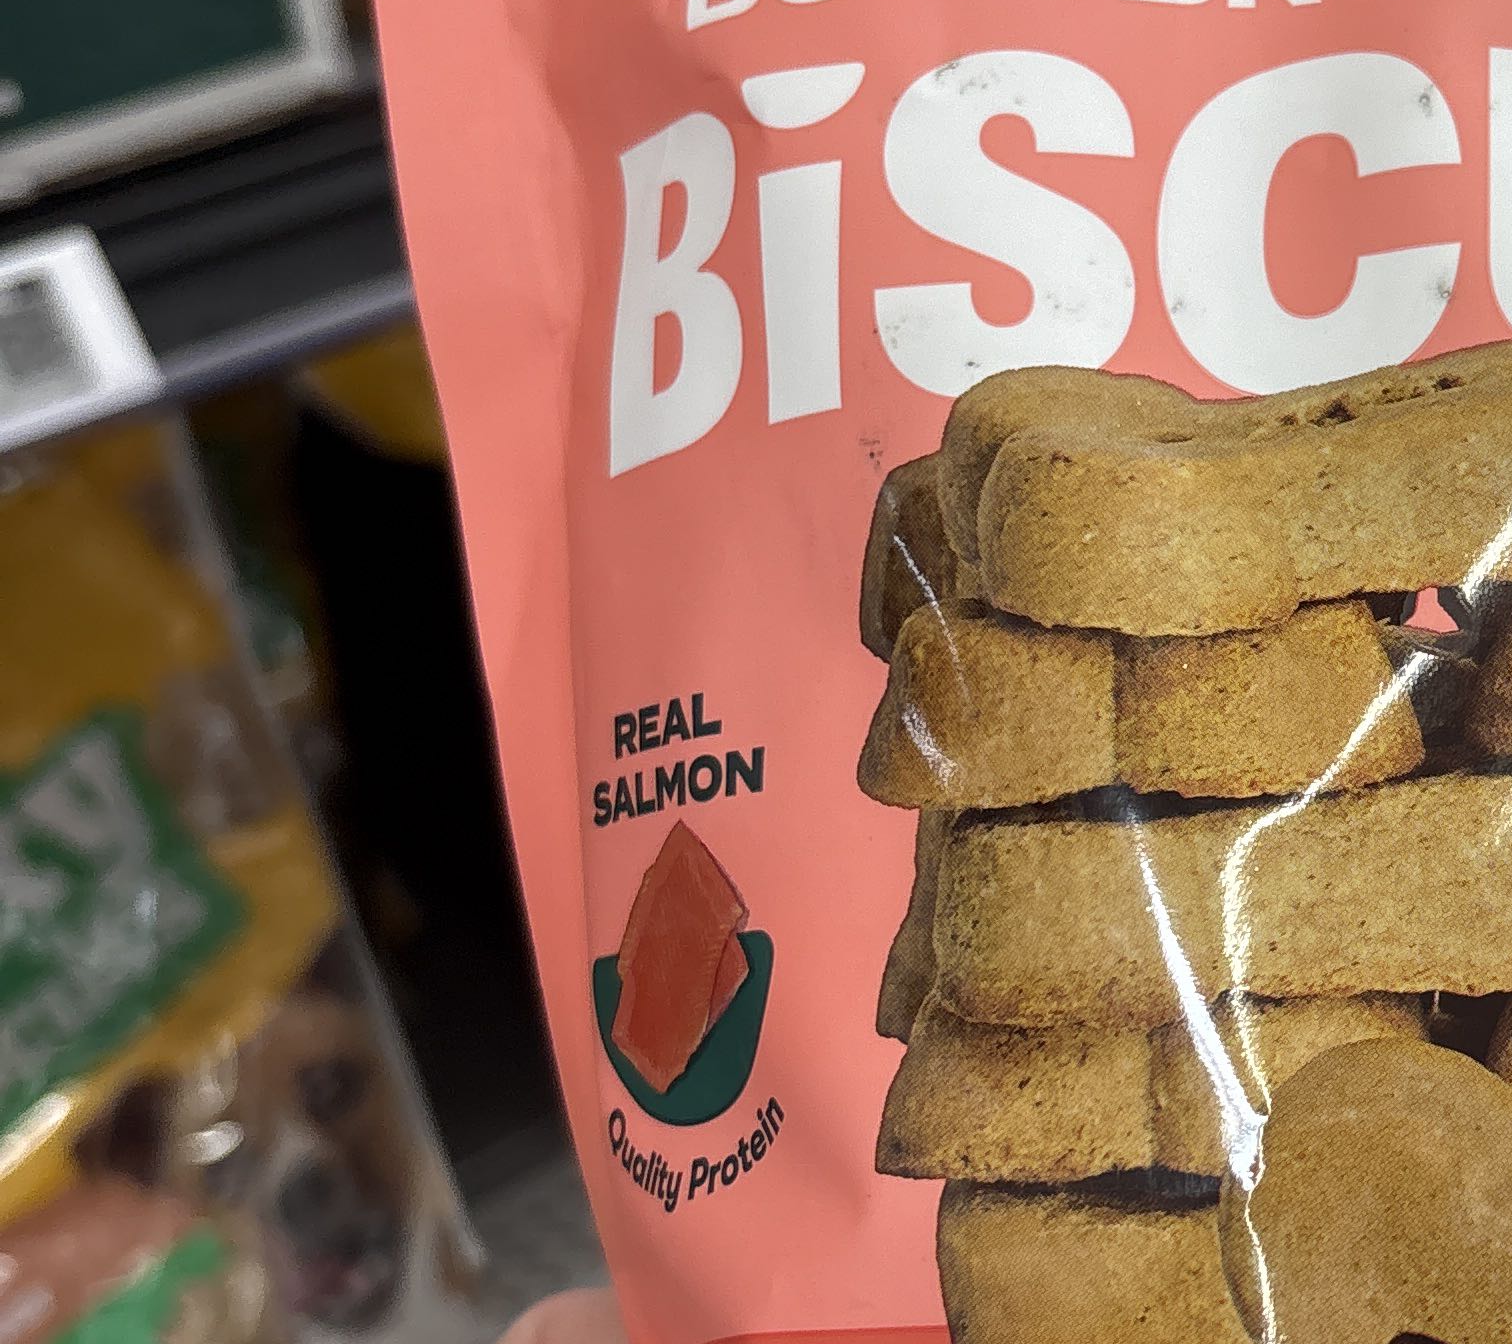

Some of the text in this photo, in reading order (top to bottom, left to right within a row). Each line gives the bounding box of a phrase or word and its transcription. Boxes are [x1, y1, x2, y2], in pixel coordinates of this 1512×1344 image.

[614, 692, 723, 759] REAL
[593, 746, 766, 828] SALMON
[607, 1096, 786, 1214] Quality Protein
